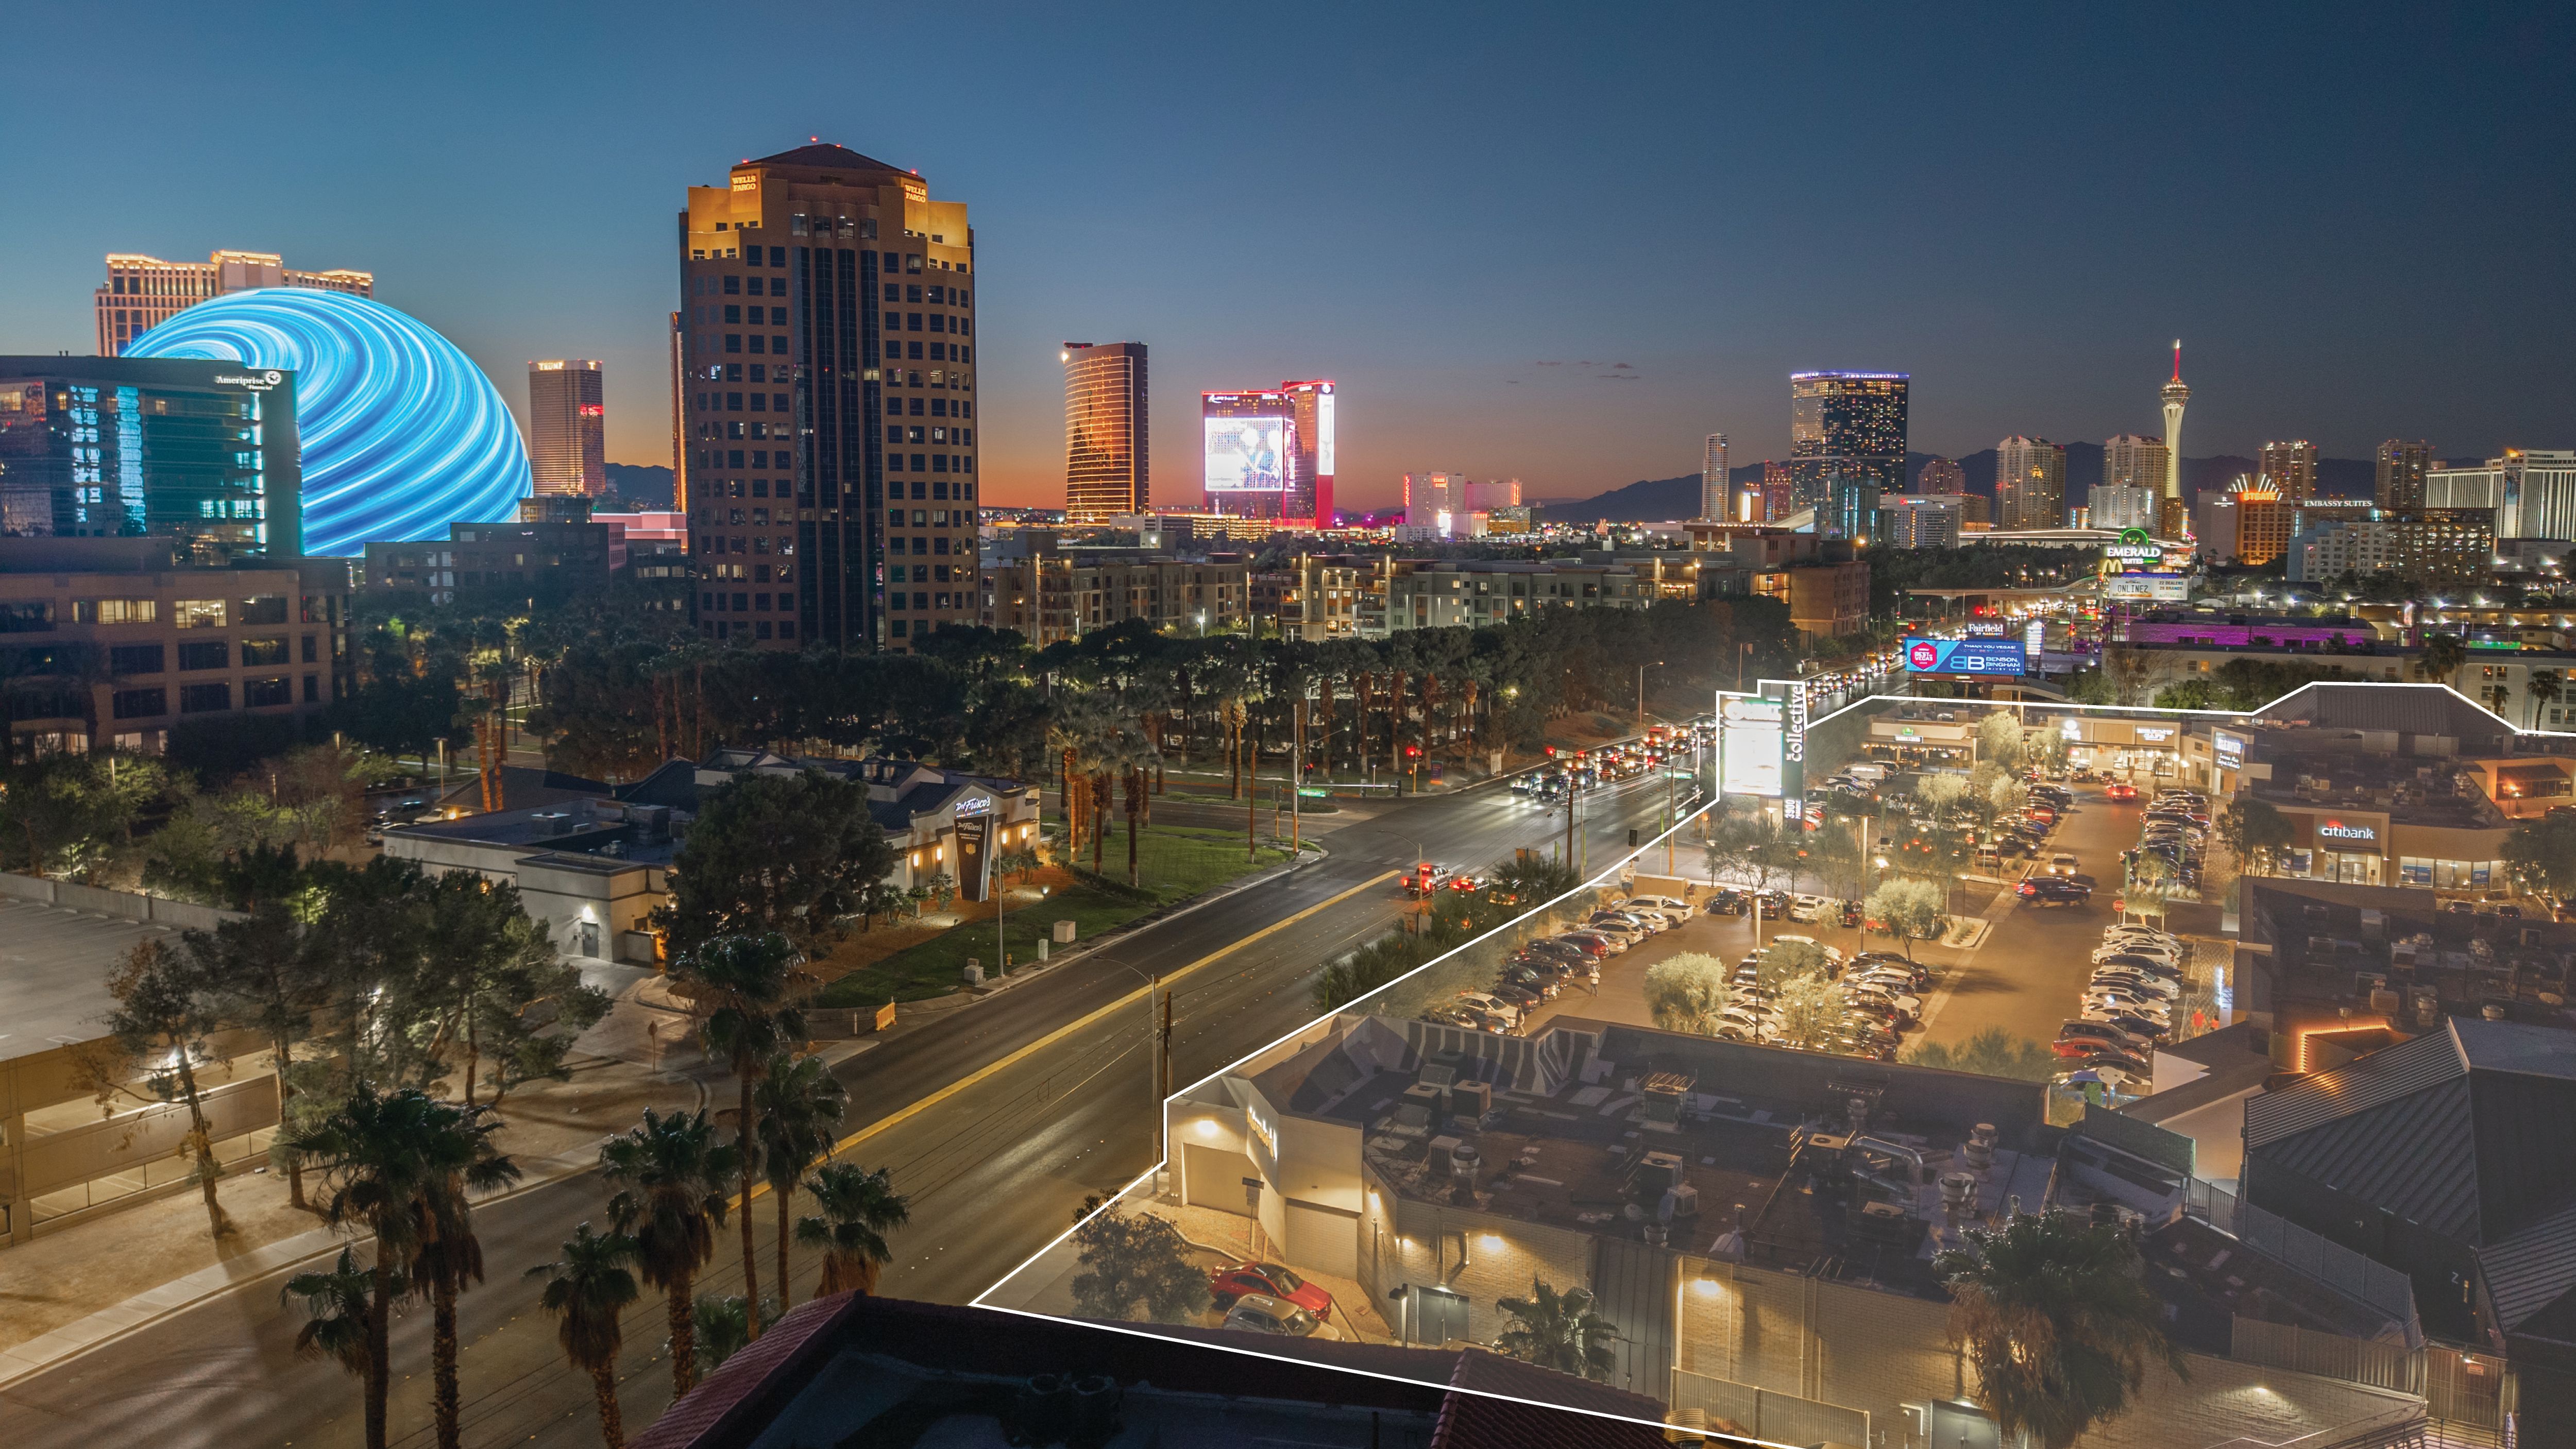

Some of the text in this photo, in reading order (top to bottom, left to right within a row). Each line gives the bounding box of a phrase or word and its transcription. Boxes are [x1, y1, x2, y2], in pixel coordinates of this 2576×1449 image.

[732, 176, 756, 184] WELLS
[905, 185, 926, 196] WELLS
[906, 193, 926, 202] FARGO
[216, 376, 264, 386] Ameriprise
[2107, 547, 2161, 557] EMERALD
[1969, 624, 2003, 632] Fairfield
[1786, 685, 1803, 762] collective
[956, 796, 990, 812] Del Frisco's
[1785, 799, 1795, 819] 3900
[2321, 825, 2375, 840] citibank
